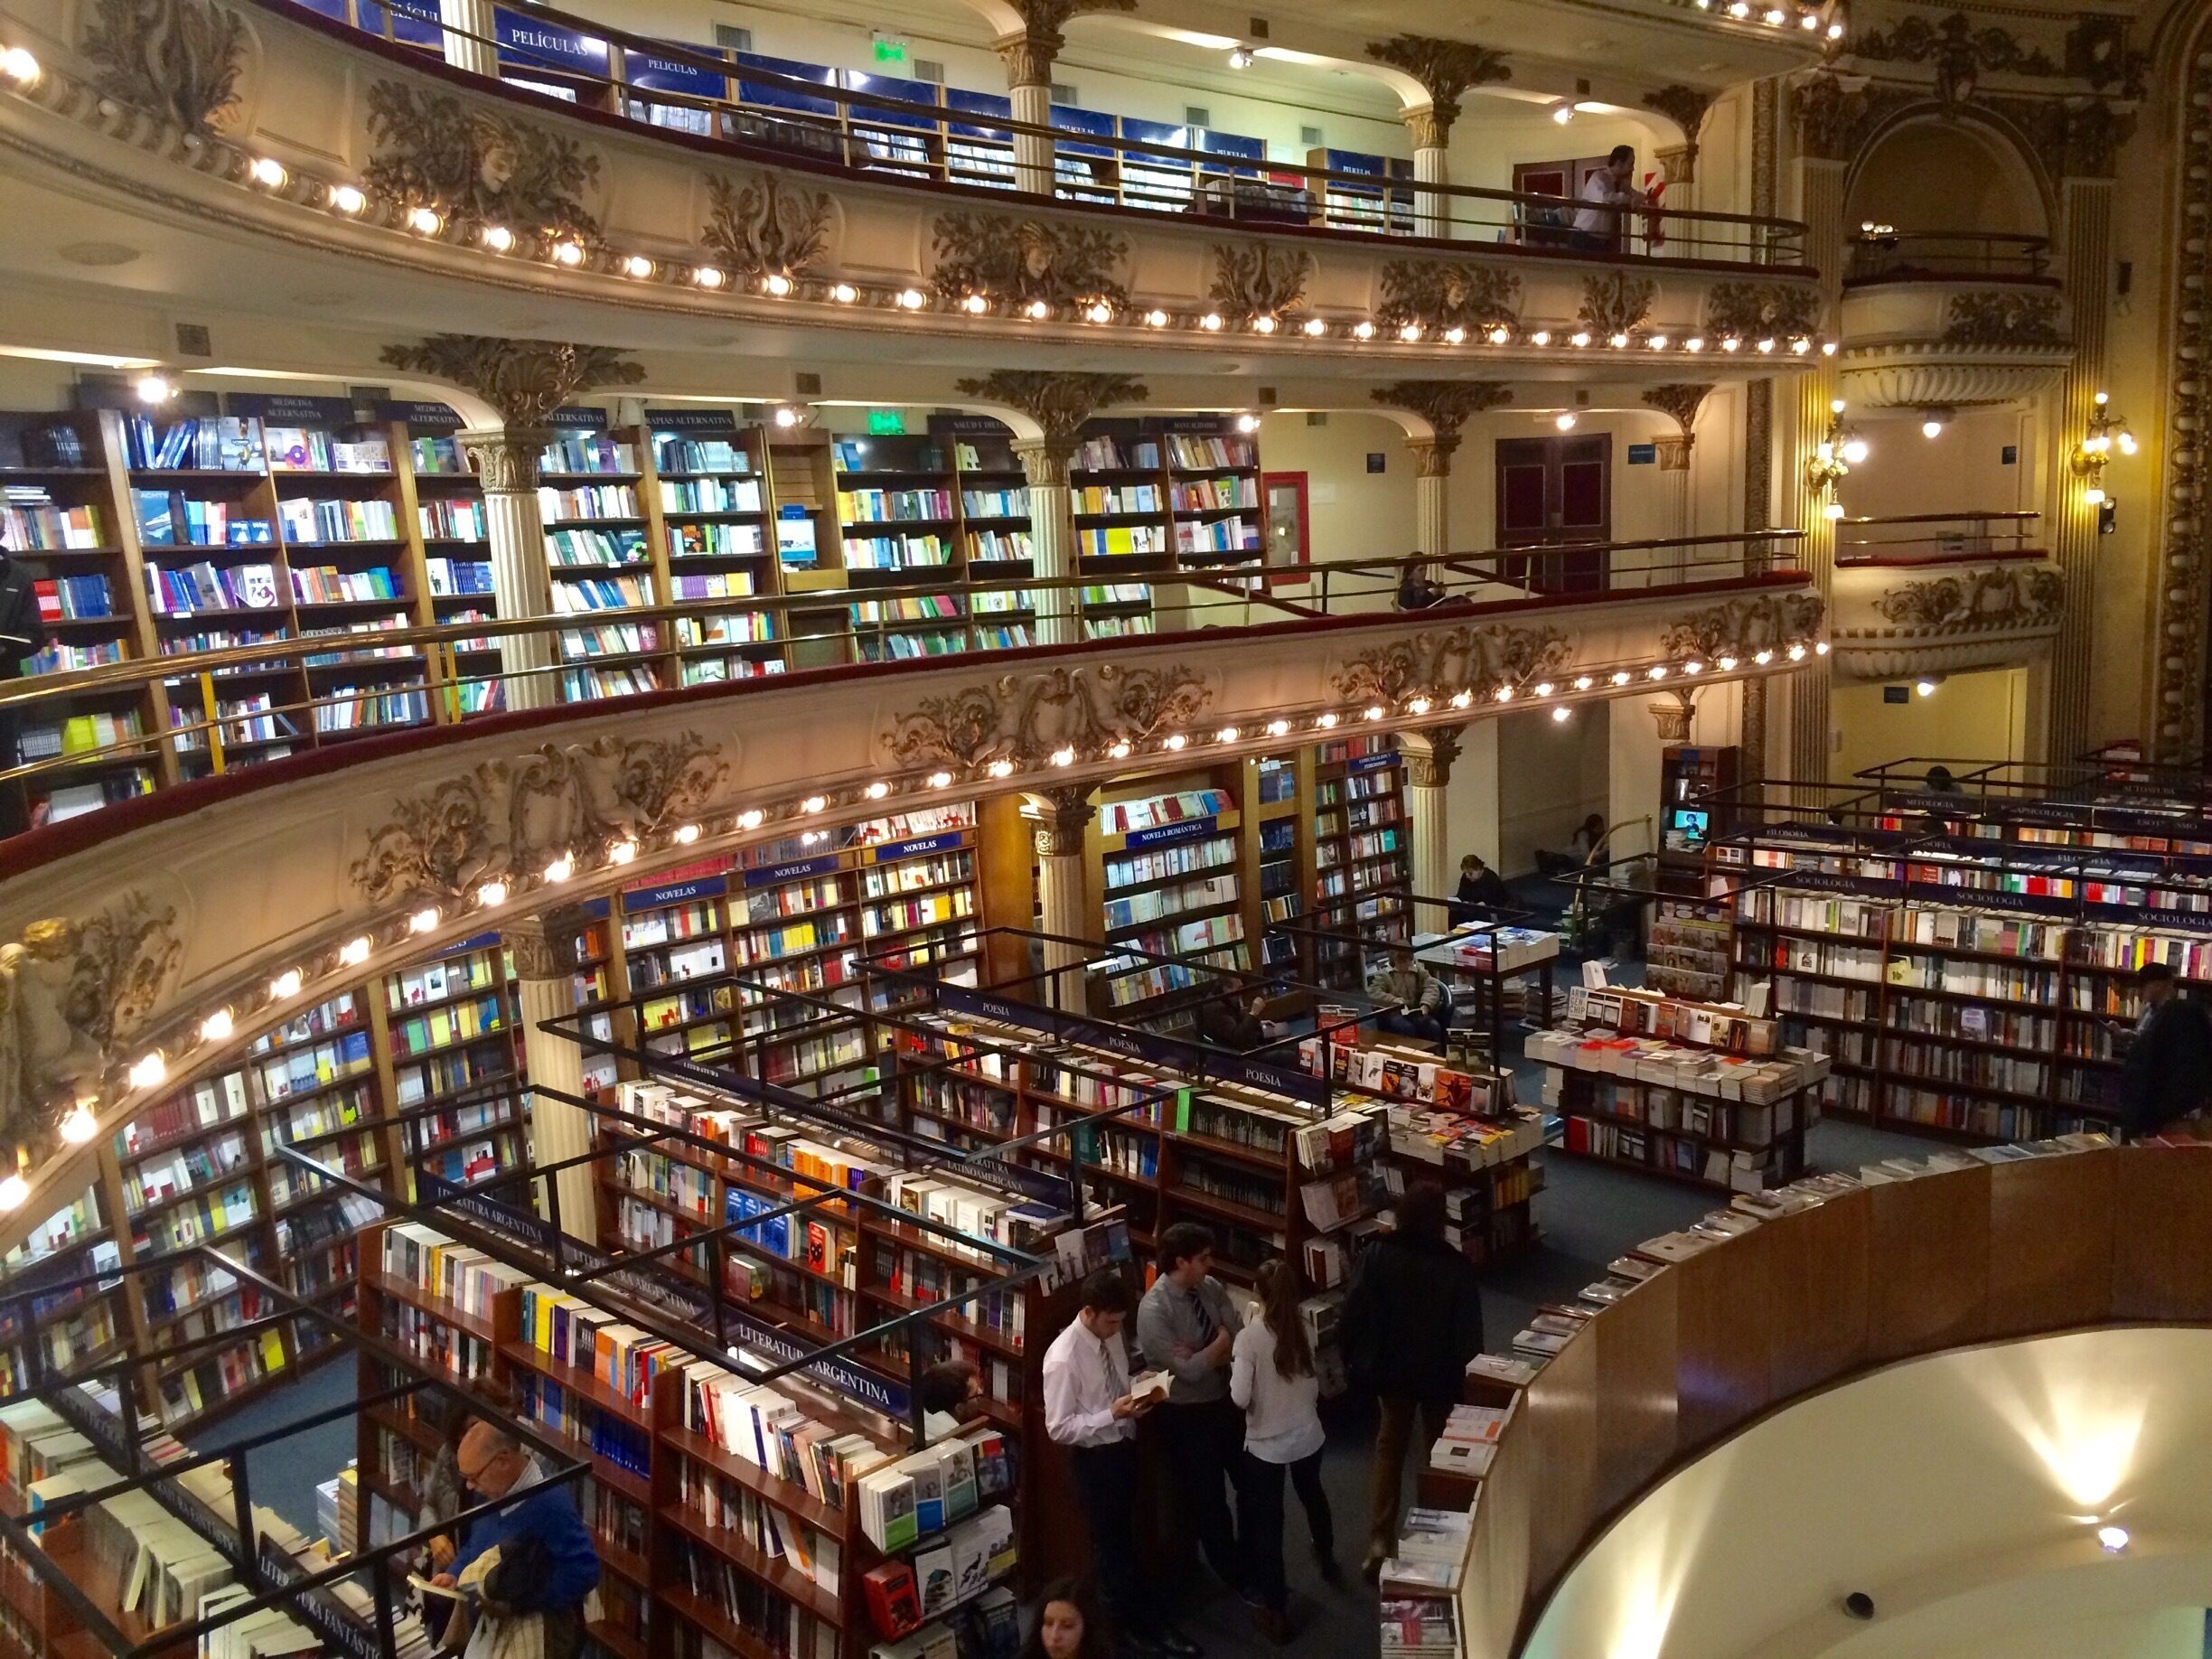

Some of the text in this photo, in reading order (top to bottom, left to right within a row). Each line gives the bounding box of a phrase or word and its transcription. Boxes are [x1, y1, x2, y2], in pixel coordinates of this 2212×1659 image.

[511, 28, 587, 56] PELÍCULAS
[648, 59, 698, 76] PELICULAS
[272, 398, 314, 407] MEDICINA
[267, 408, 322, 418] ALTERNATIVA
[547, 414, 605, 423] ALTERNATIVAS
[646, 417, 673, 425] RAPIAS
[2001, 804, 2075, 820] PAPSICOLOGIA
[1141, 823, 1203, 841] NOVELA ROMÁNTICA
[1767, 829, 1809, 839] FILOSOFIA
[904, 839, 937, 854] NOVELAS
[2057, 854, 2111, 866] FILOOFIA
[774, 864, 811, 878] NOVELAS
[1795, 876, 1855, 889] SOCIOLOGIA
[655, 886, 697, 902] NOVELAS
[1956, 891, 2024, 908] SOCIOLOGIA
[2138, 911, 2212, 928] SOCIOLOGIA
[982, 1002, 1010, 1017] POESIA
[1109, 1036, 1140, 1054] POESIA
[1245, 1068, 1281, 1087] POESIA
[947, 1160, 1024, 1193] LATINOAMERICANA
[491, 1209, 543, 1242] ARGENTINA
[814, 1360, 891, 1406] ARGENTINA
